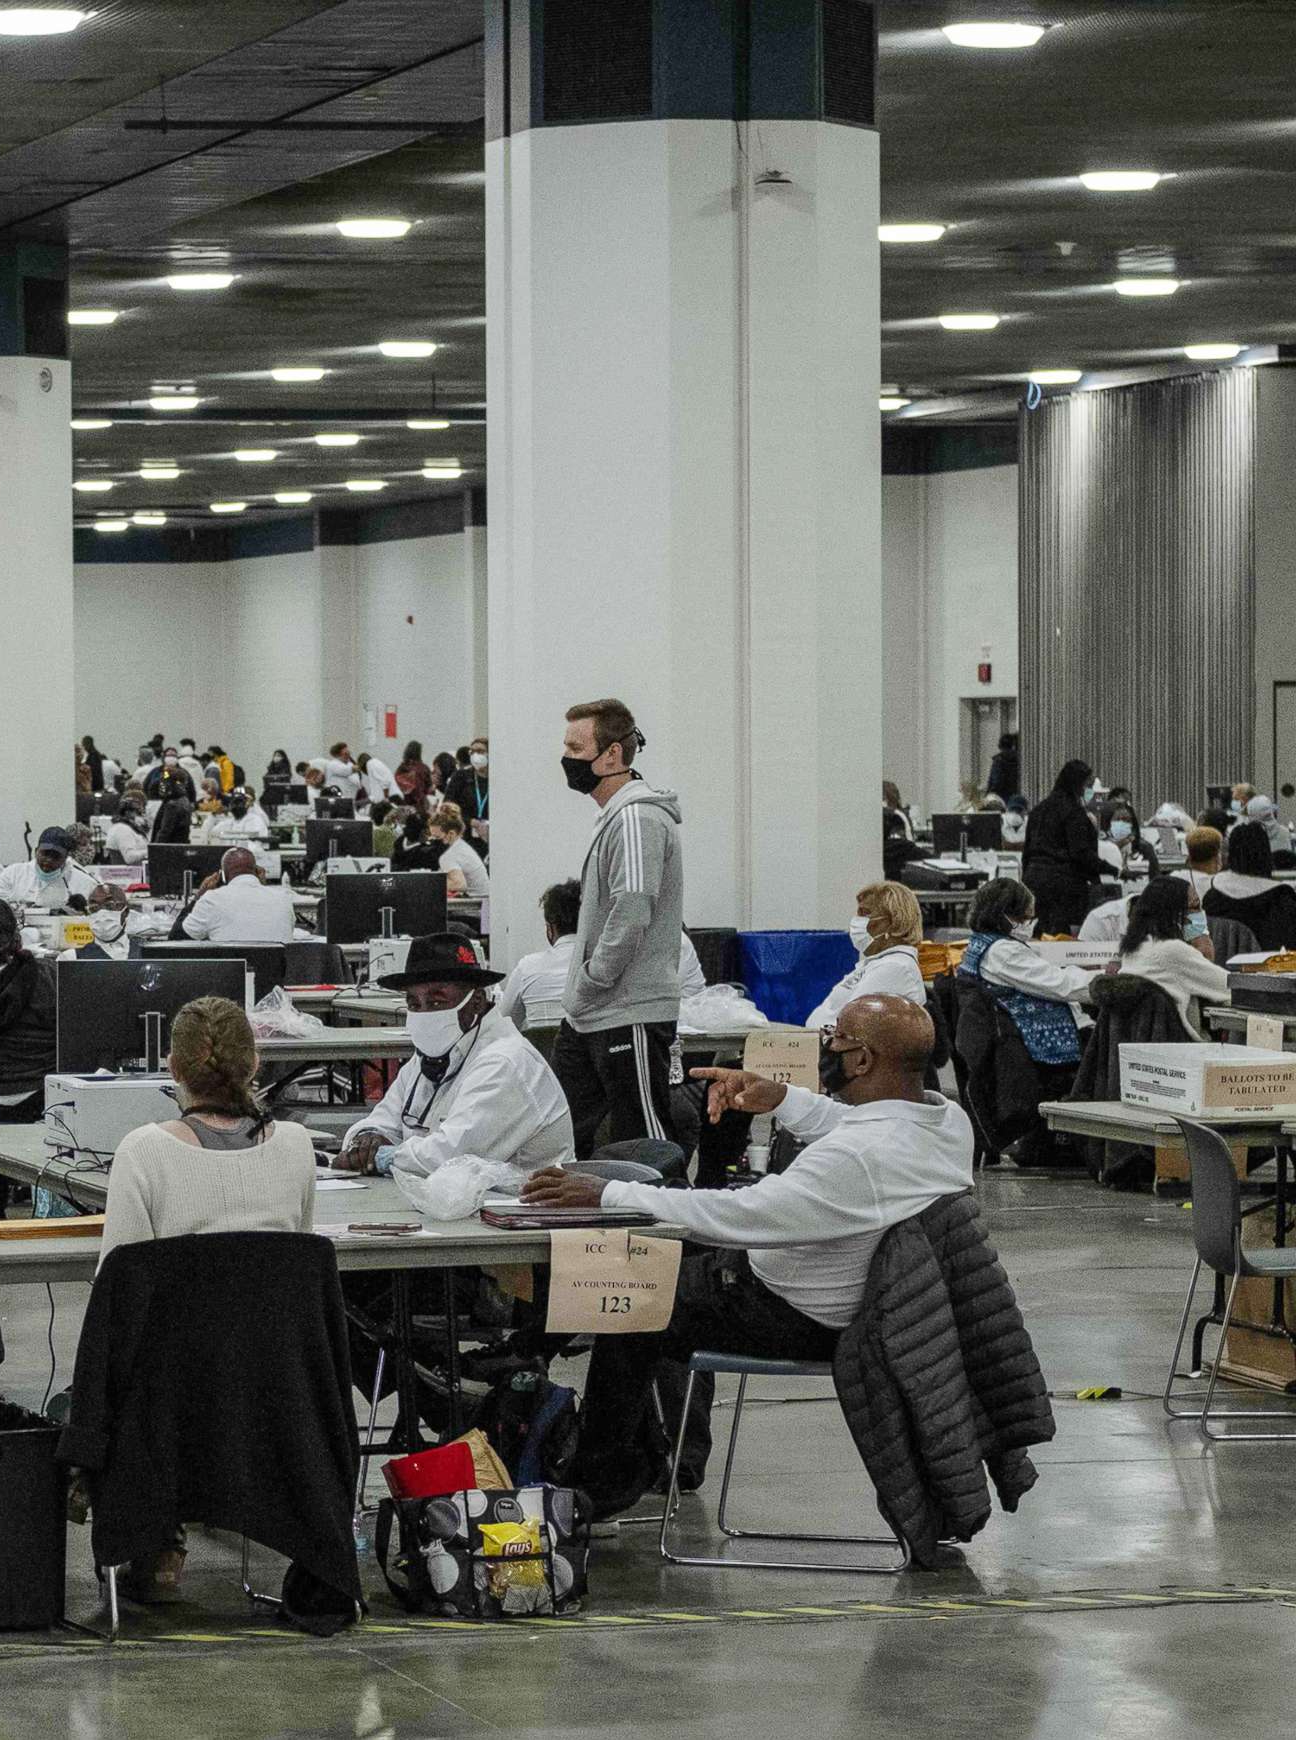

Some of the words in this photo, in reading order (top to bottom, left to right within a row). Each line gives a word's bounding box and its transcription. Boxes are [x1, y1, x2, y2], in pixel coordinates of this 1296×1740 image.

[1155, 1067, 1168, 1076] POSTAL
[1169, 1070, 1186, 1079] SERVICE
[1221, 1074, 1265, 1083] BALLOTS
[1282, 1073, 1295, 1081] BE
[1229, 1085, 1286, 1095] TABULATED
[585, 1243, 607, 1254] ICC
[629, 1246, 649, 1256] #24
[584, 1281, 627, 1289] COUNTING
[628, 1282, 658, 1290] BOARD
[599, 1295, 632, 1314] 123
